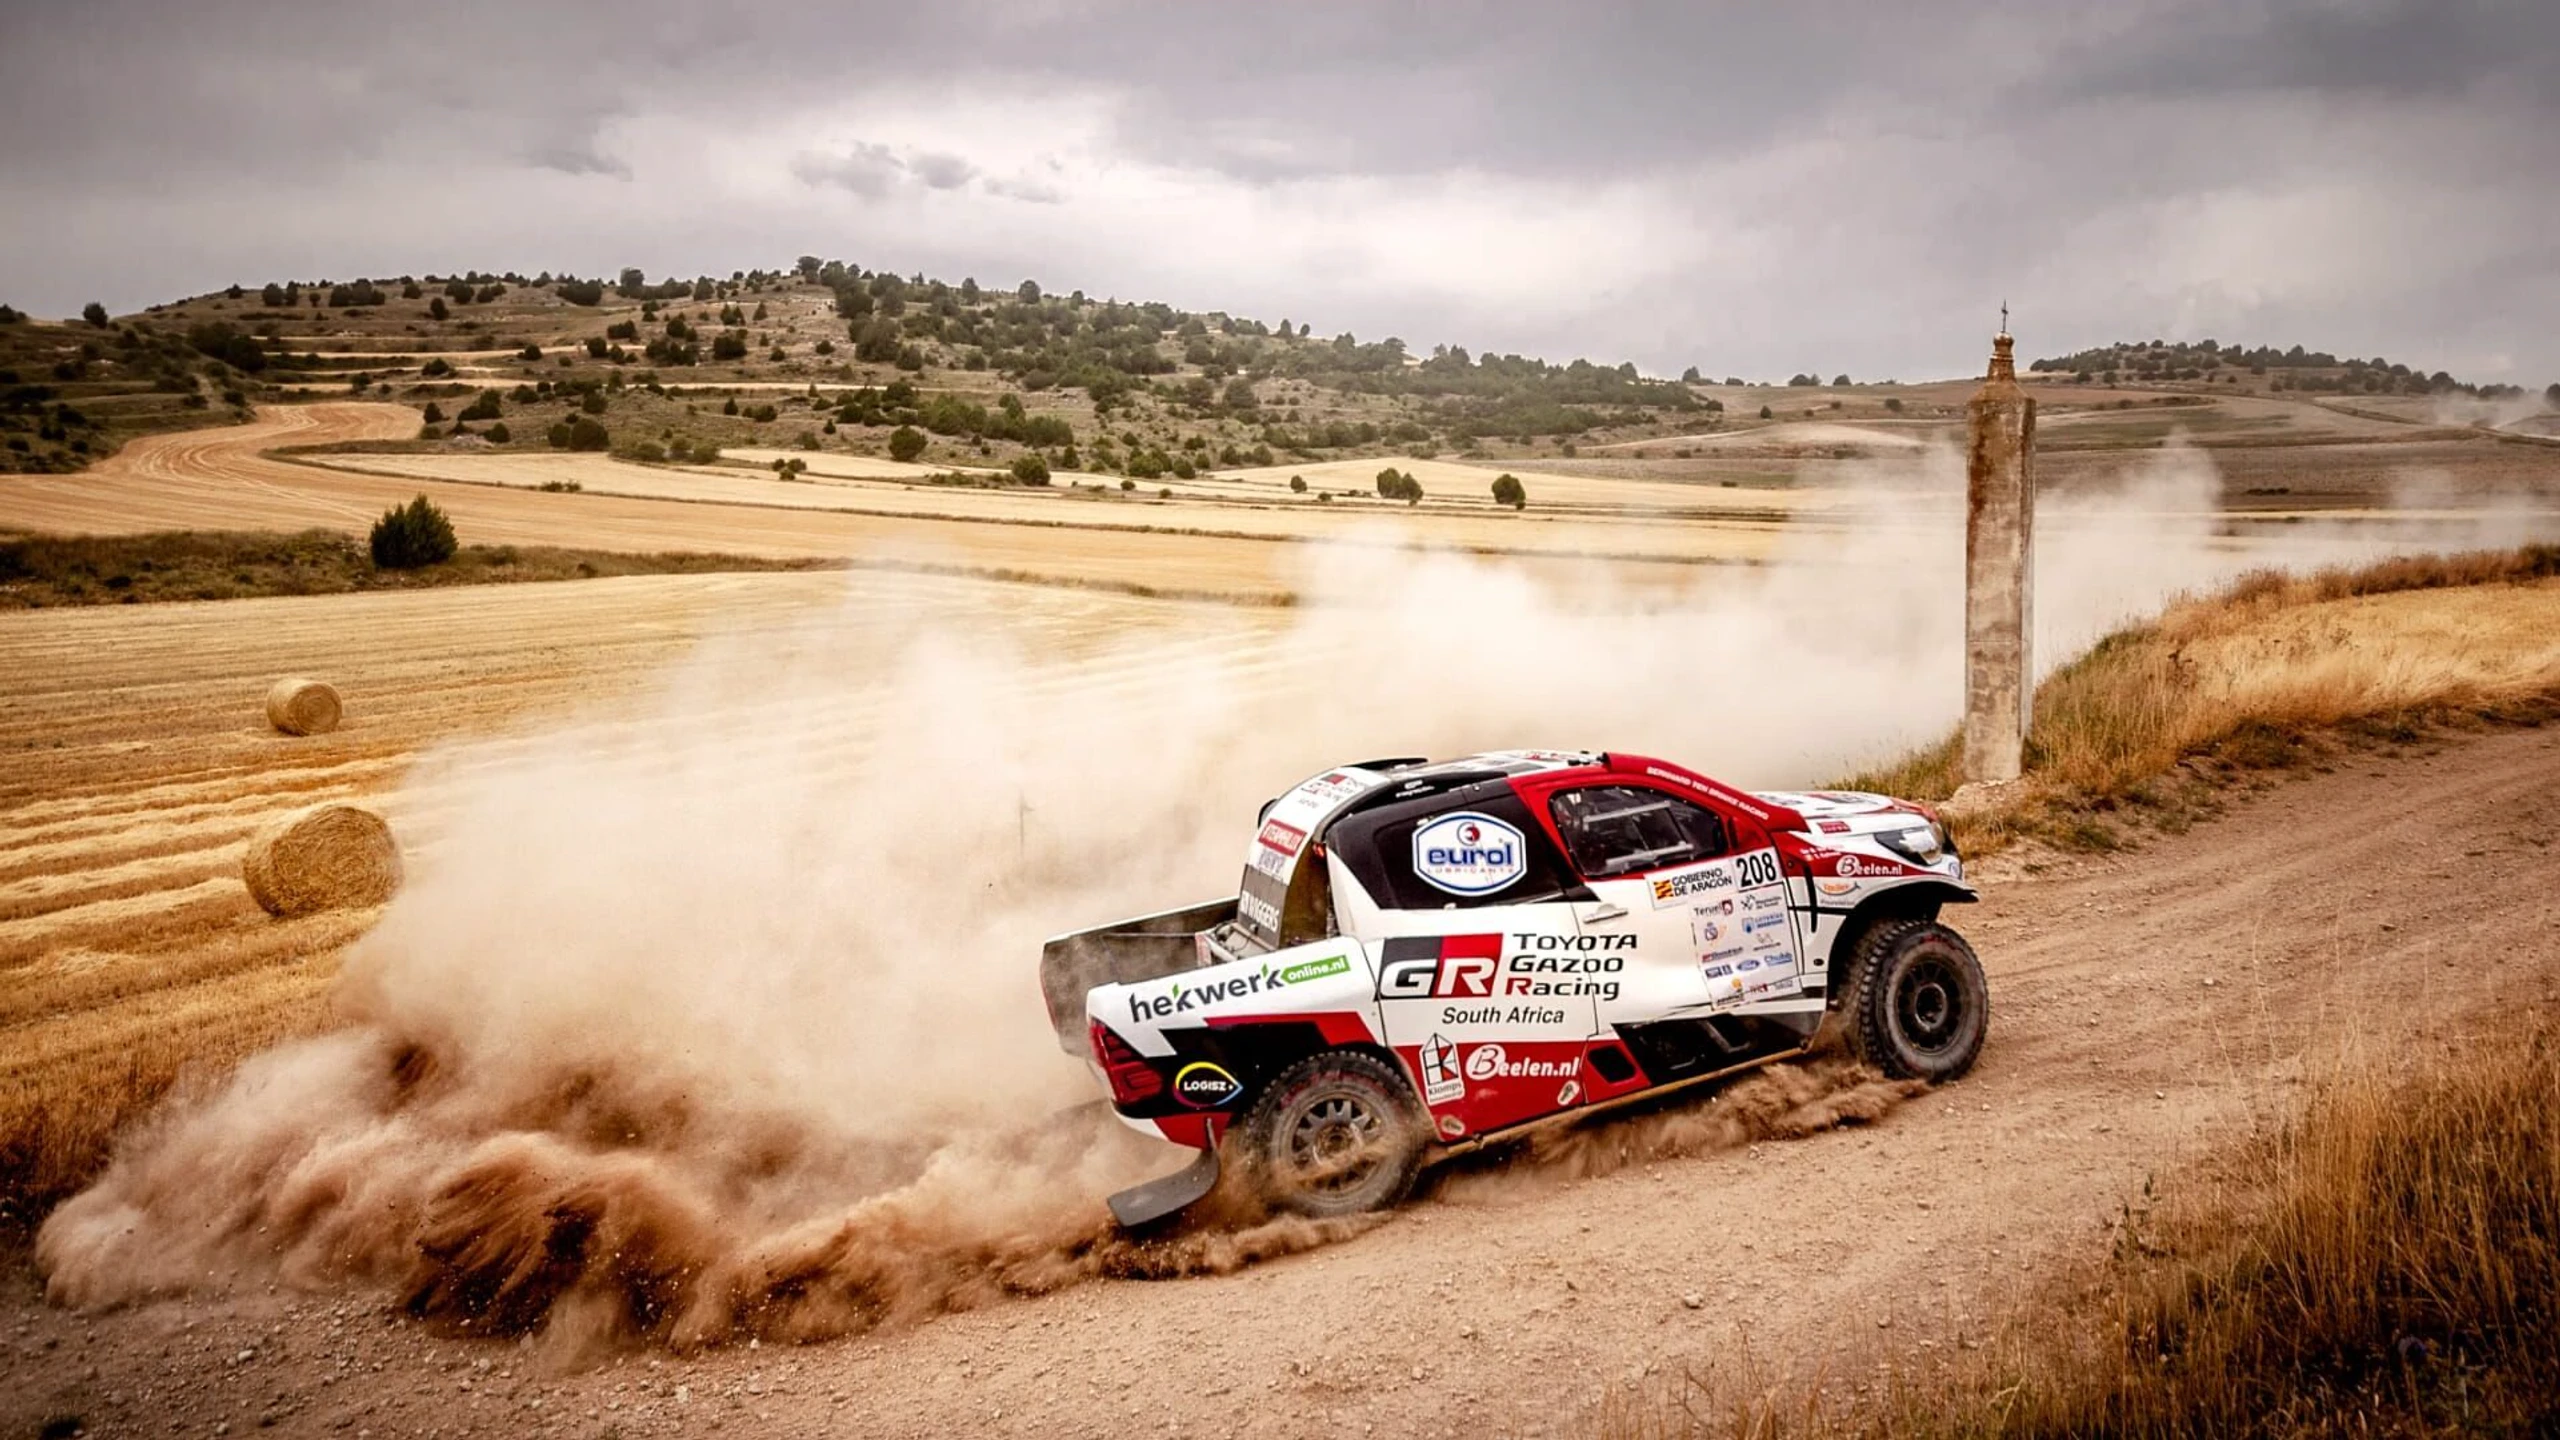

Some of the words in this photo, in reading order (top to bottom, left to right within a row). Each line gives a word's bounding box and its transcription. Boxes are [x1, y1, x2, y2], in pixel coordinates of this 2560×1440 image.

[1738, 801, 1769, 821] RACING
[1427, 843, 1513, 866] eurol
[1736, 852, 1777, 888] 208
[1836, 854, 1903, 877] Beelen.nl
[1671, 867, 1723, 886] GOBIERNO
[1673, 885, 1688, 897] DE
[1512, 933, 1638, 951] TOYOTA
[1508, 955, 1624, 973] GAZOO
[1380, 957, 1496, 998] GR
[1505, 977, 1620, 1000] Racing
[1441, 1006, 1501, 1025] South
[1506, 1007, 1565, 1025] Africa
[1467, 1045, 1581, 1079] Beelen.nl
[1183, 1080, 1227, 1092] LOGISZ
